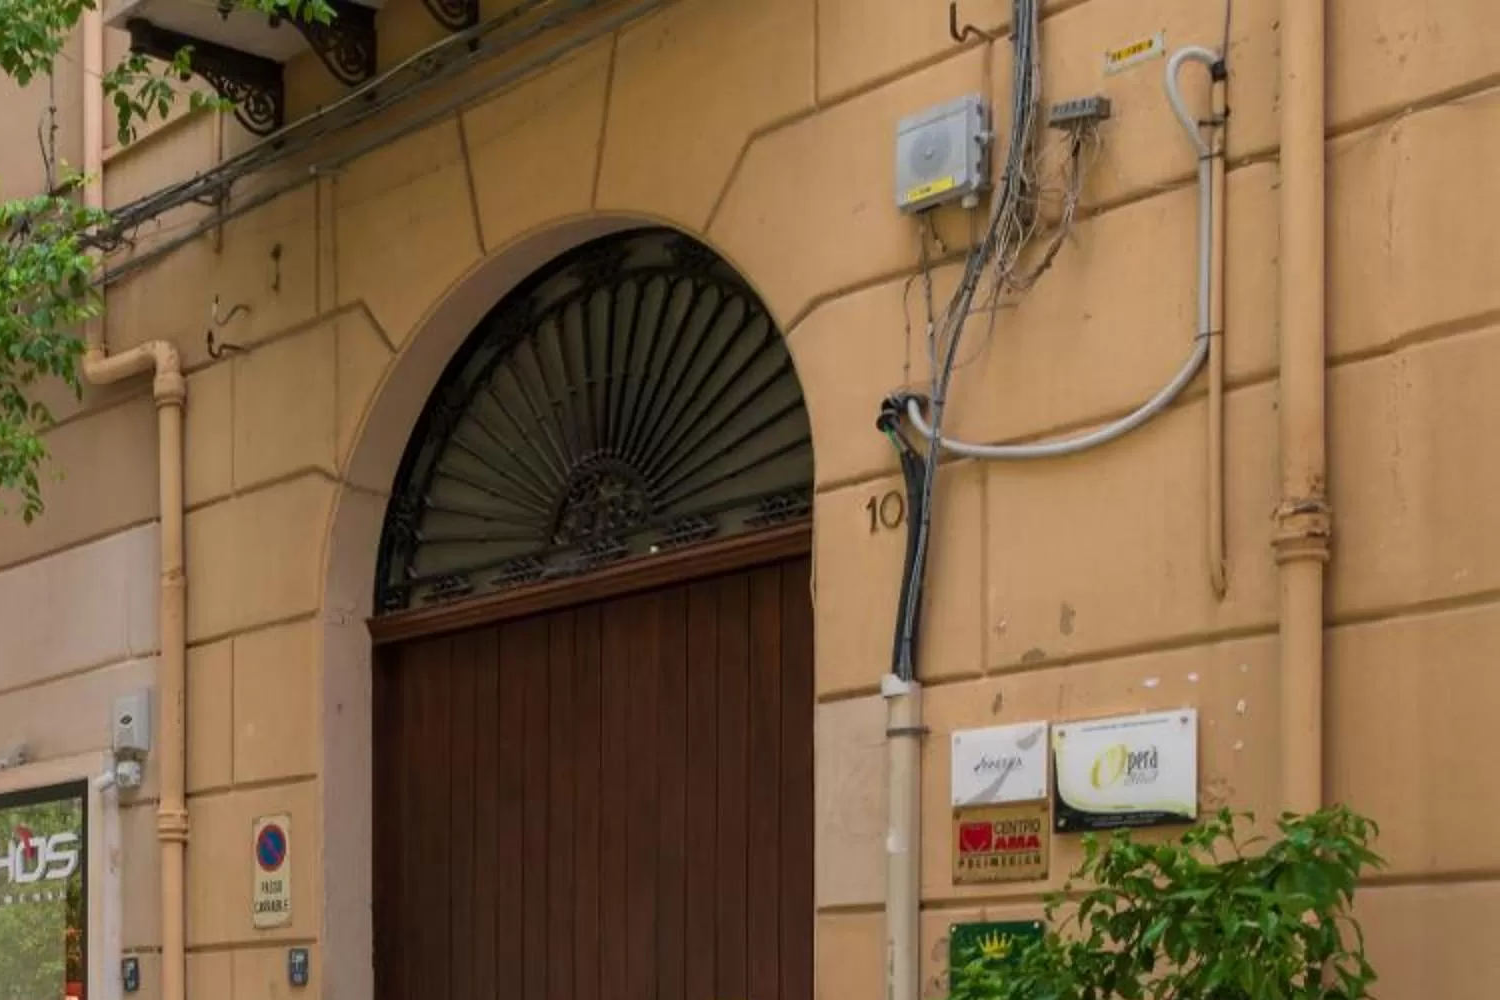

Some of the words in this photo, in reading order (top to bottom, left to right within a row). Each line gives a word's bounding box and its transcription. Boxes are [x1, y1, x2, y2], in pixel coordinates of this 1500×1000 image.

[866, 489, 905, 536] 10
[995, 818, 1041, 834] CENTRO
[995, 834, 1042, 850] AMA
